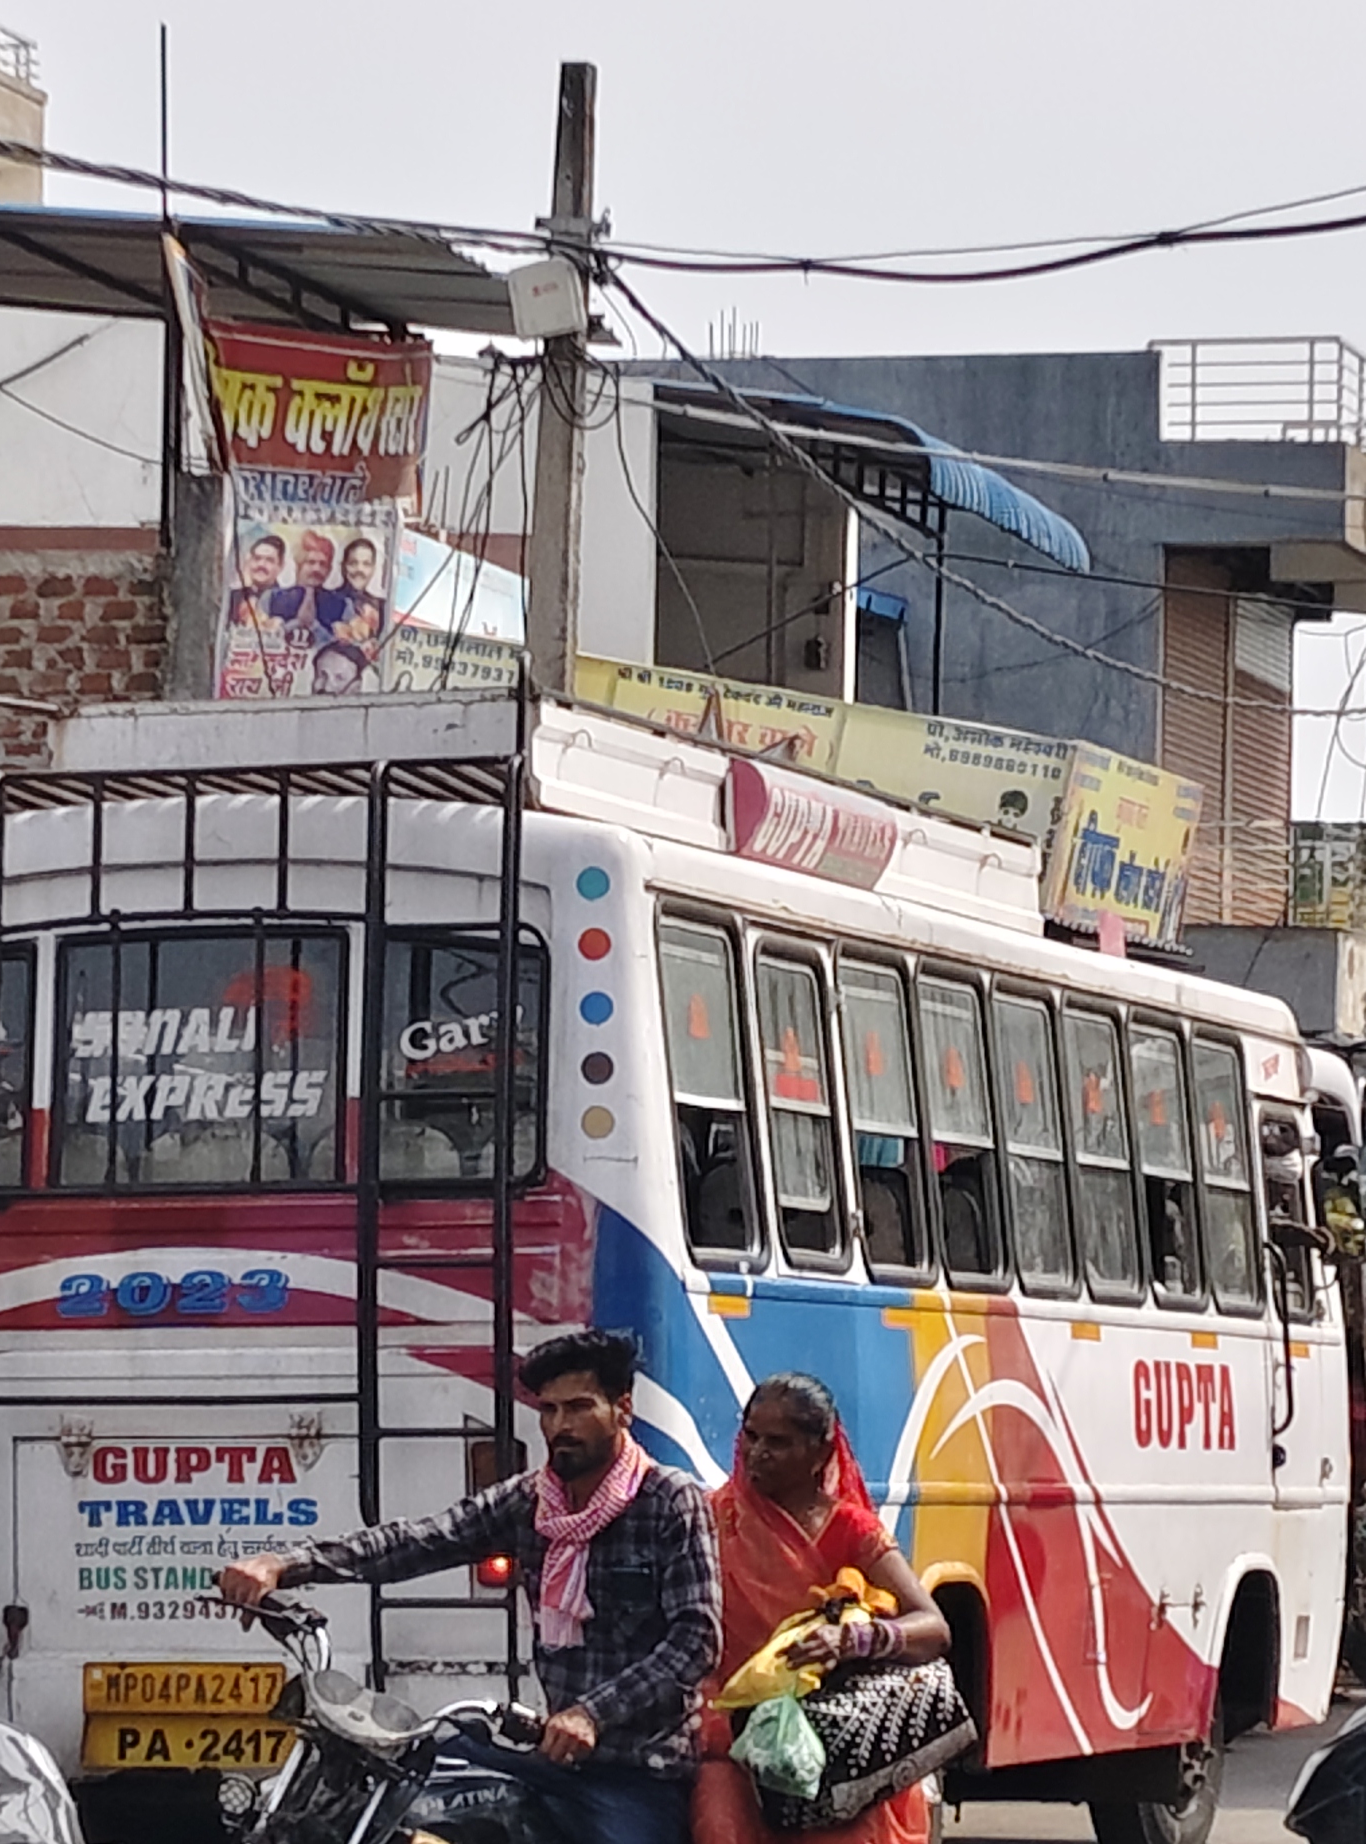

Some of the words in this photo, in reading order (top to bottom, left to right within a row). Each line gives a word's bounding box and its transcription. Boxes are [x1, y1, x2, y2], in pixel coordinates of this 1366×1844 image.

[752, 786, 835, 871] GUPTA
[70, 1004, 258, 1058] SONALI
[86, 1069, 328, 1124] EXPRESS
[56, 1267, 291, 1318] 2023
[1134, 1358, 1236, 1451] GUPTA
[92, 1446, 298, 1485] GUPTA
[77, 1498, 319, 1527] TRAVELS
[78, 1566, 127, 1590] BUS
[105, 1672, 279, 1705] MP04PA2417
